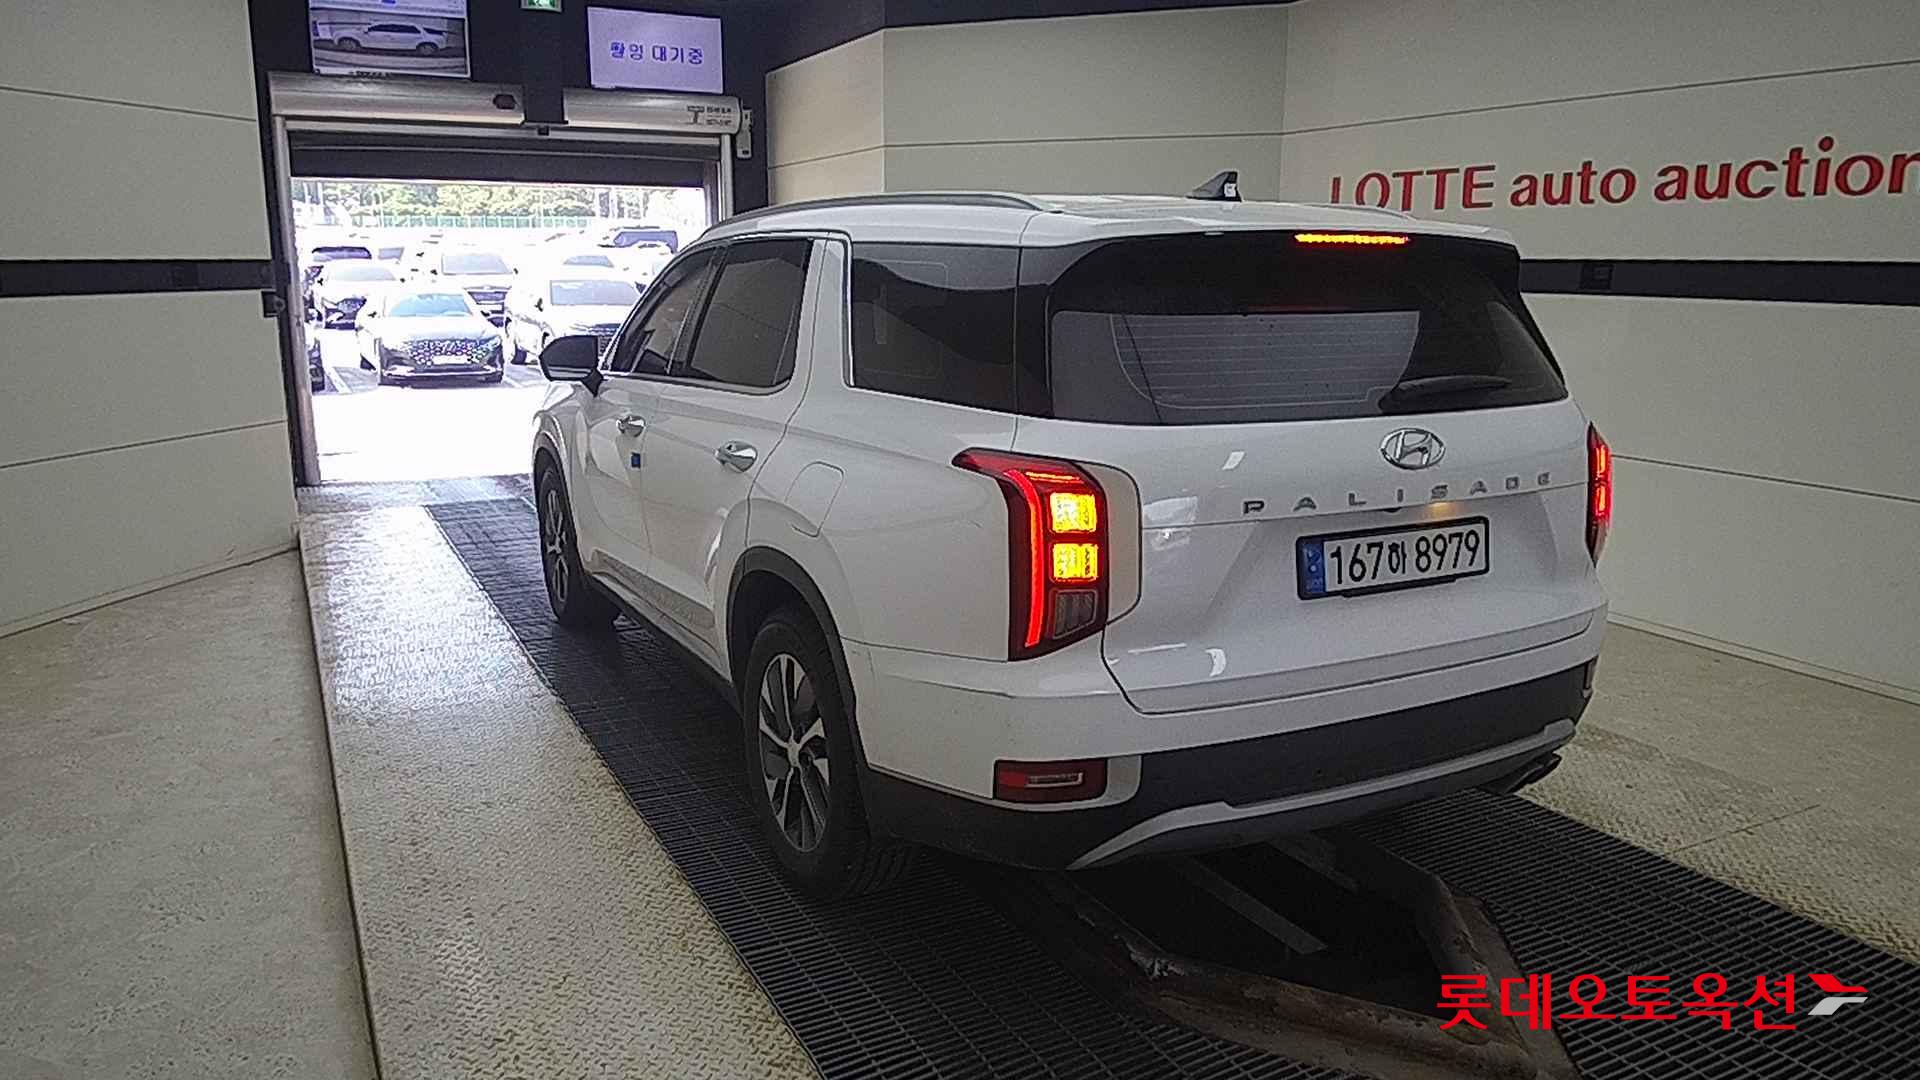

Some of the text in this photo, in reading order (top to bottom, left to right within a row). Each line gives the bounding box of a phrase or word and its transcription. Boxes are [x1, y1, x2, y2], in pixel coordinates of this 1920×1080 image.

[651, 45, 703, 65] 대기중
[1510, 161, 1636, 206] auto
[1242, 471, 1552, 516] PALISADE
[1415, 529, 1480, 573] 8979
